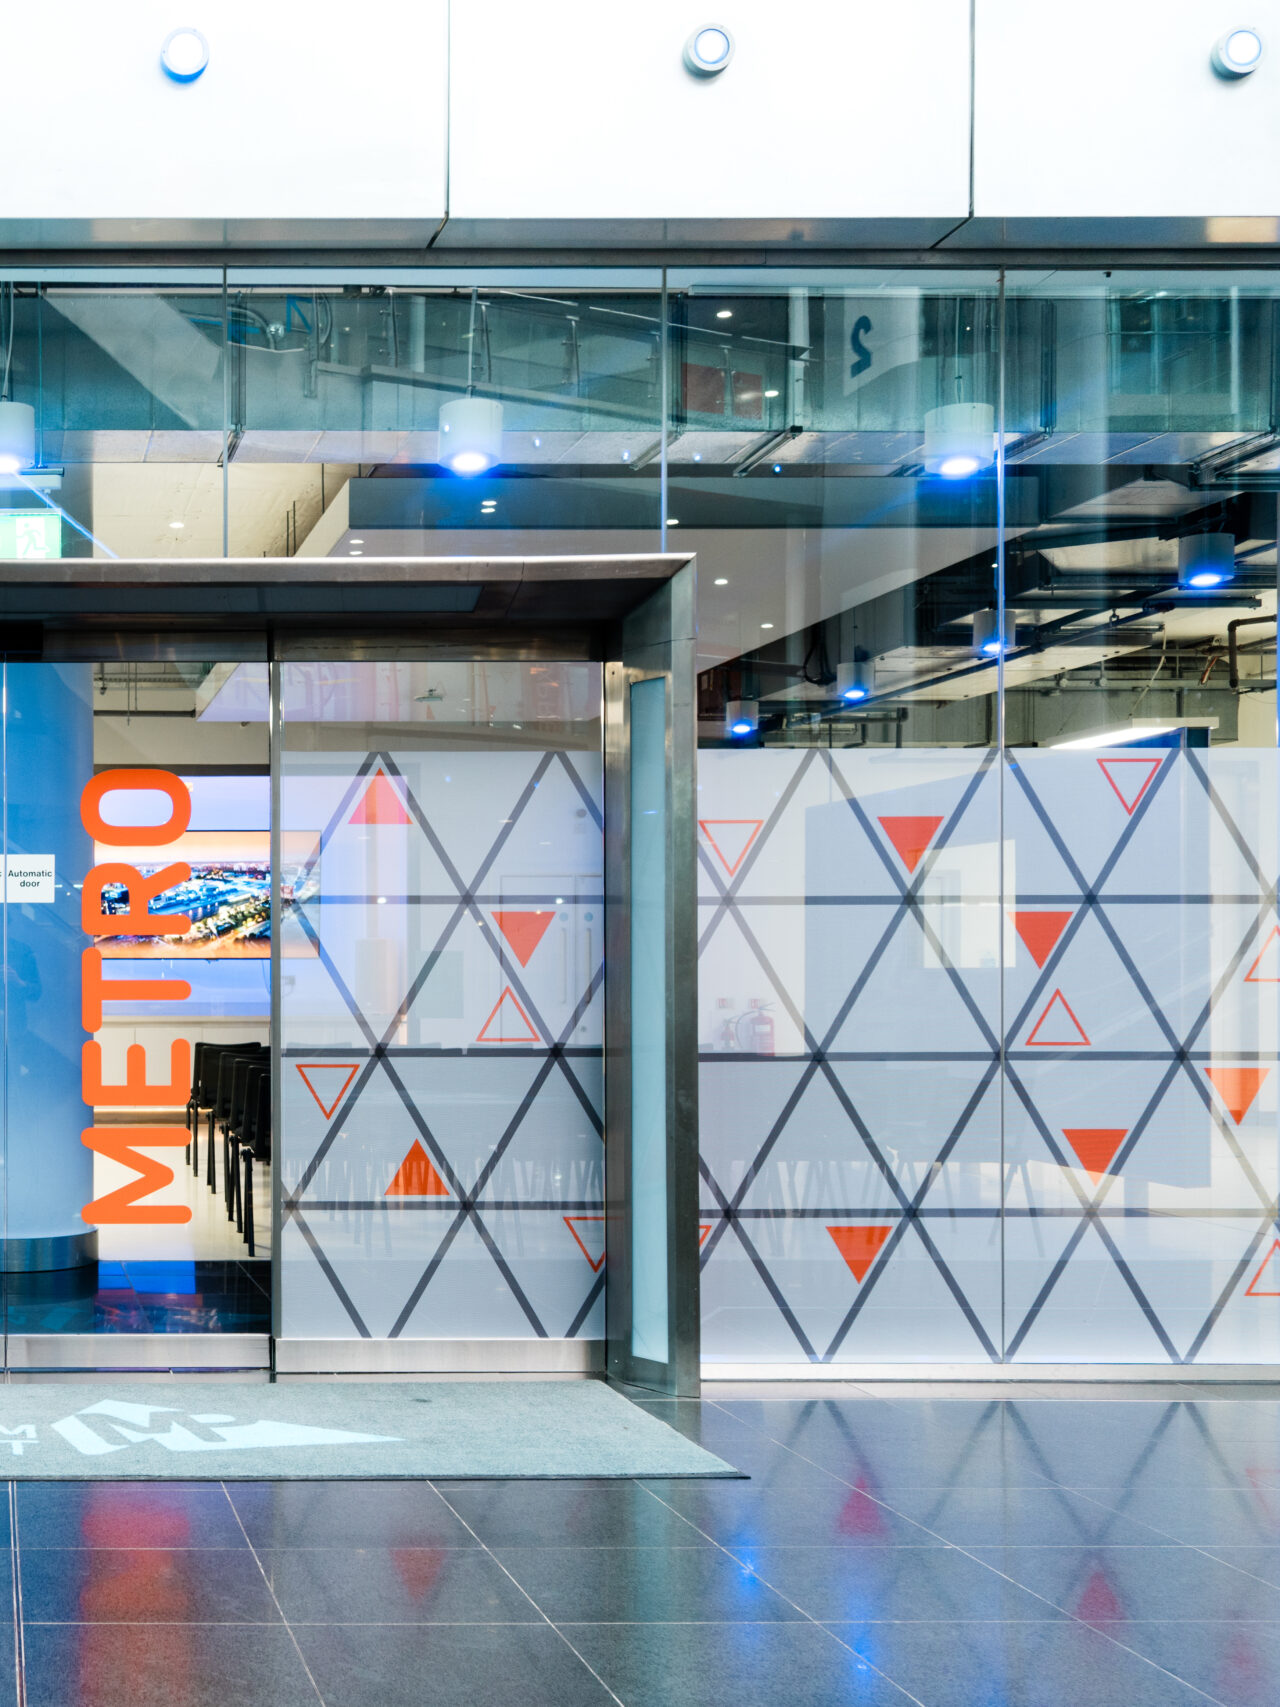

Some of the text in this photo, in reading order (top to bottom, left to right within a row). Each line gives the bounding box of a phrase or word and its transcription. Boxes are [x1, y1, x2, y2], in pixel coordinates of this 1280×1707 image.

[7, 870, 53, 878] Automatic
[19, 880, 40, 888] door
[79, 768, 193, 1225] METRO
